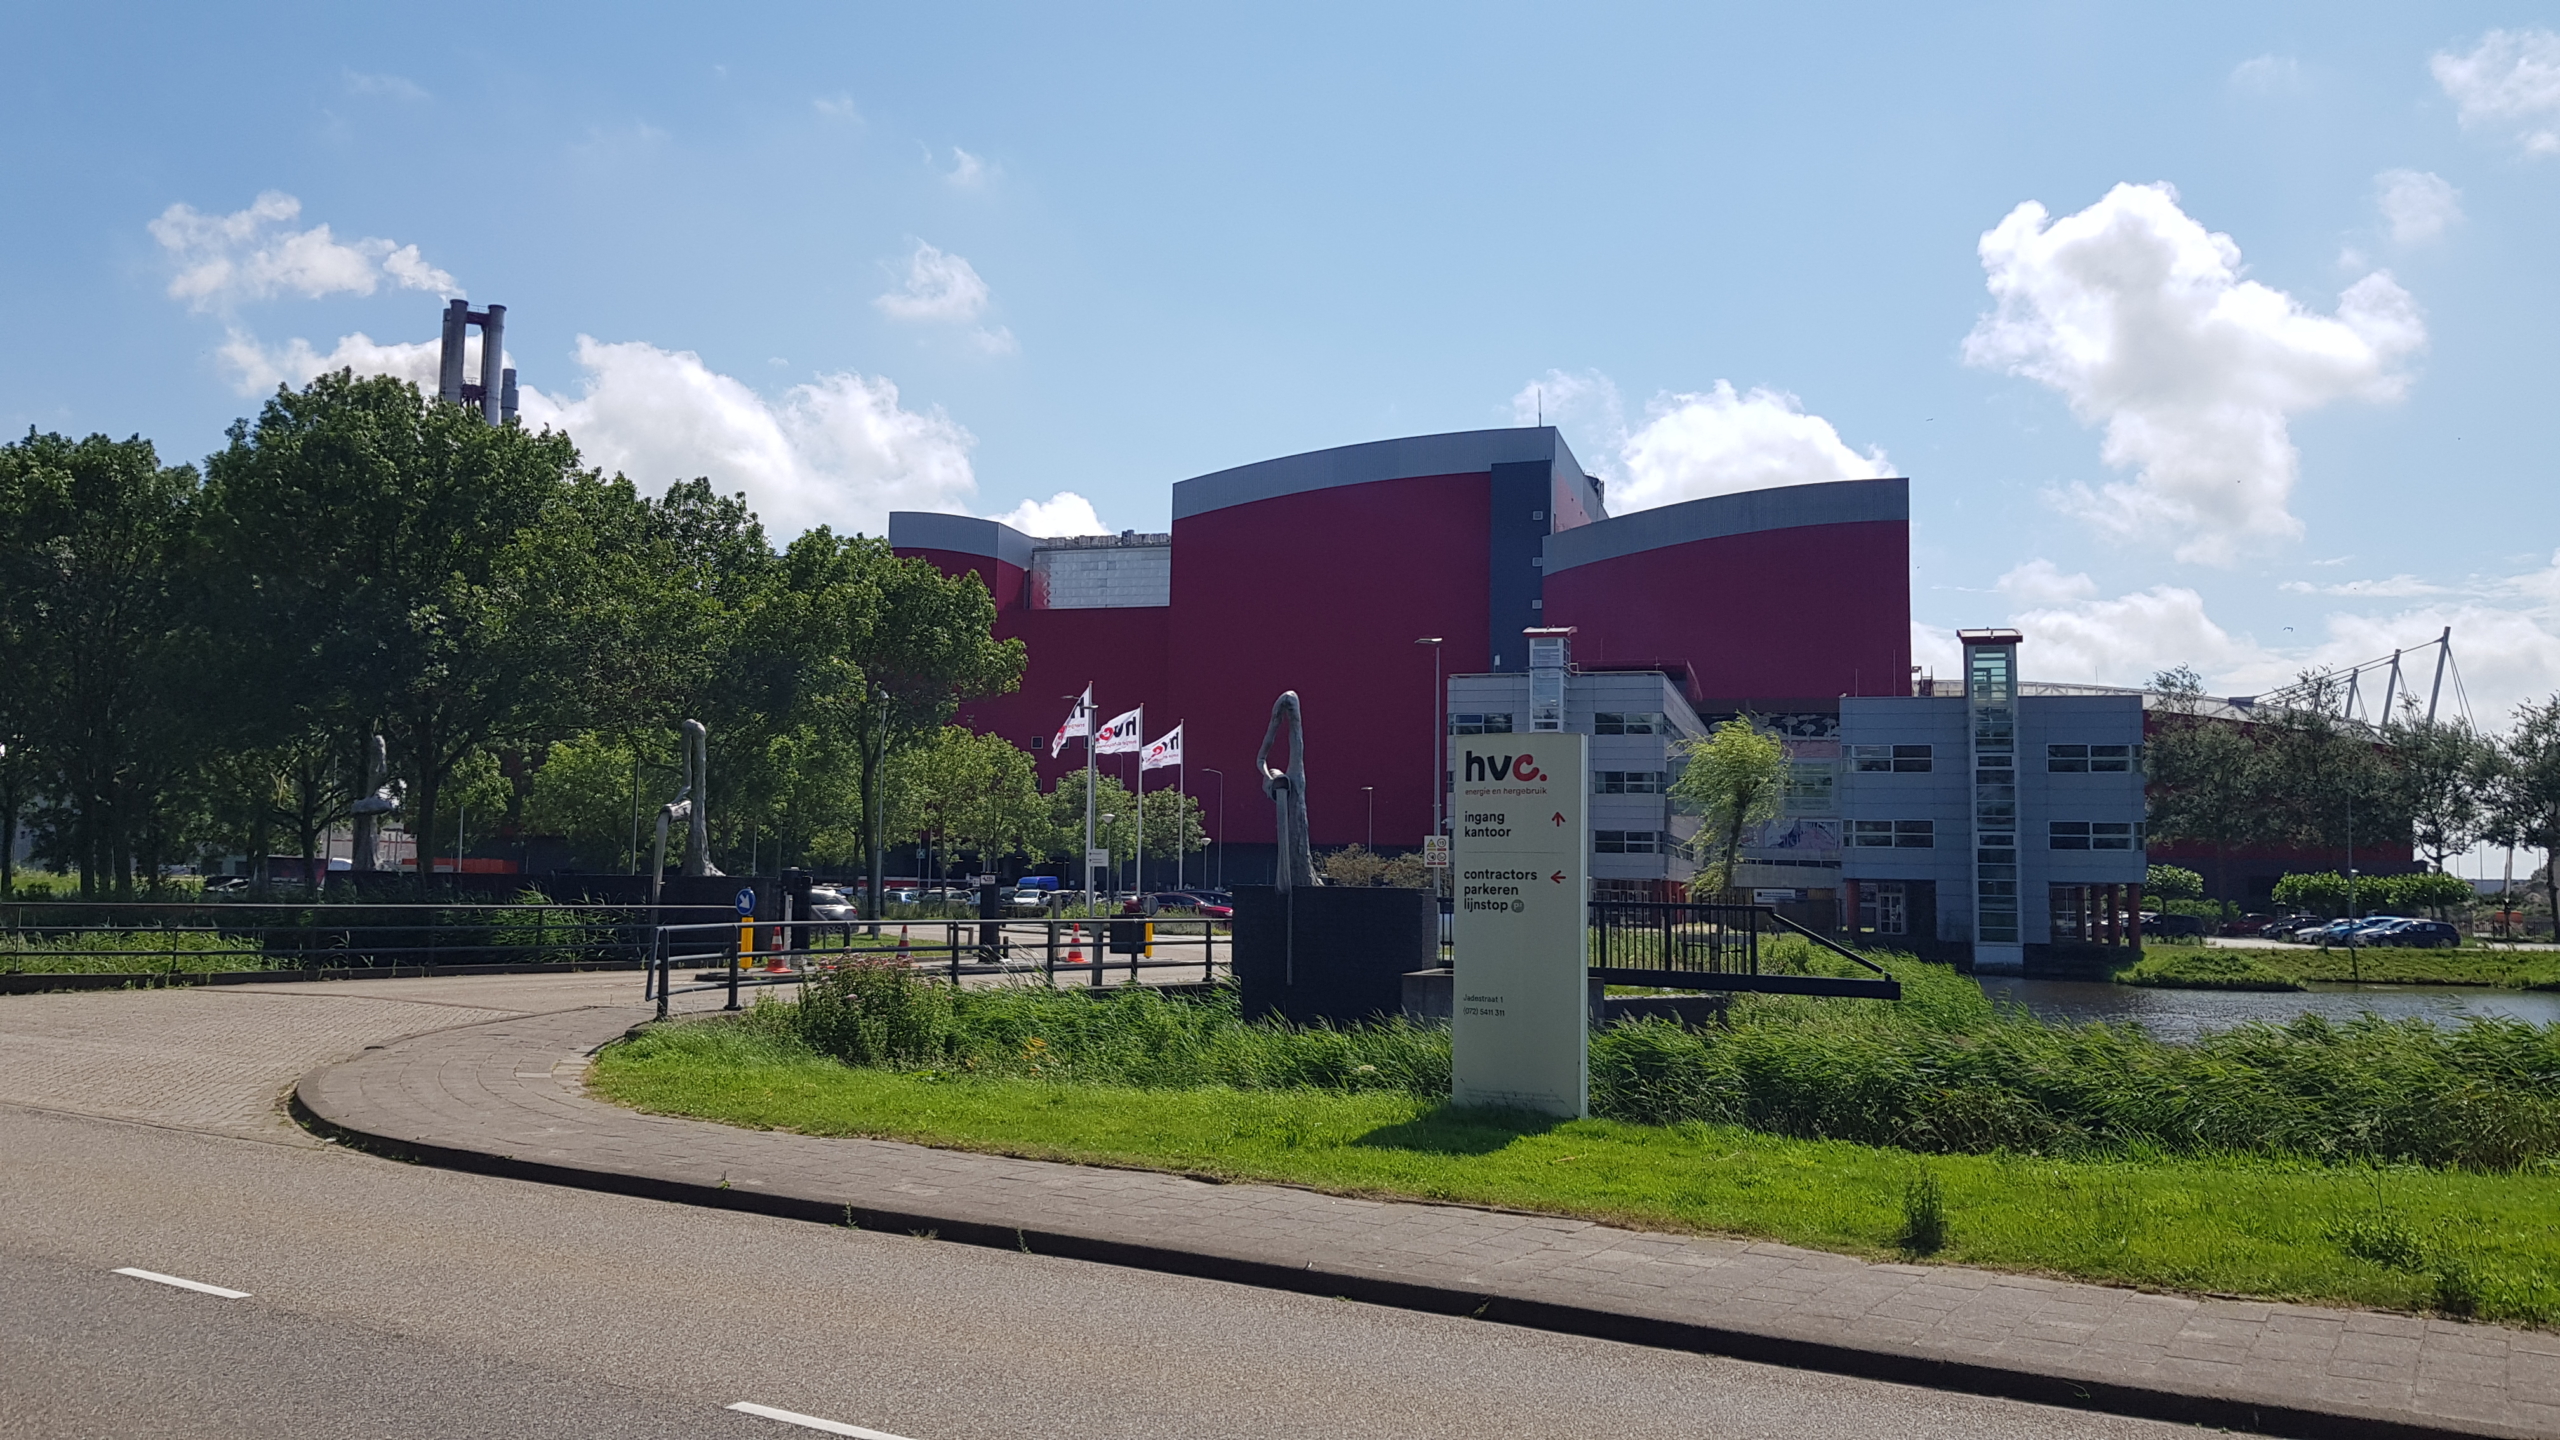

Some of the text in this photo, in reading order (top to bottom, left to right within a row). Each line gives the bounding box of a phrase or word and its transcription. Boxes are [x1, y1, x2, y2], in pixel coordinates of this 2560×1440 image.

[1465, 787, 1490, 796] energie
[1503, 787, 1547, 796] hergebruik
[1464, 811, 1505, 825] ingang
[1464, 825, 1511, 837] kantoor
[1464, 868, 1538, 880] contractors
[1464, 883, 1519, 896] parkeren
[1464, 898, 1508, 913] lijnstop
[1463, 994, 1498, 1002] Jadestraat
[1463, 1006, 1478, 1015] (072)
[1480, 1008, 1493, 1016] 5411
